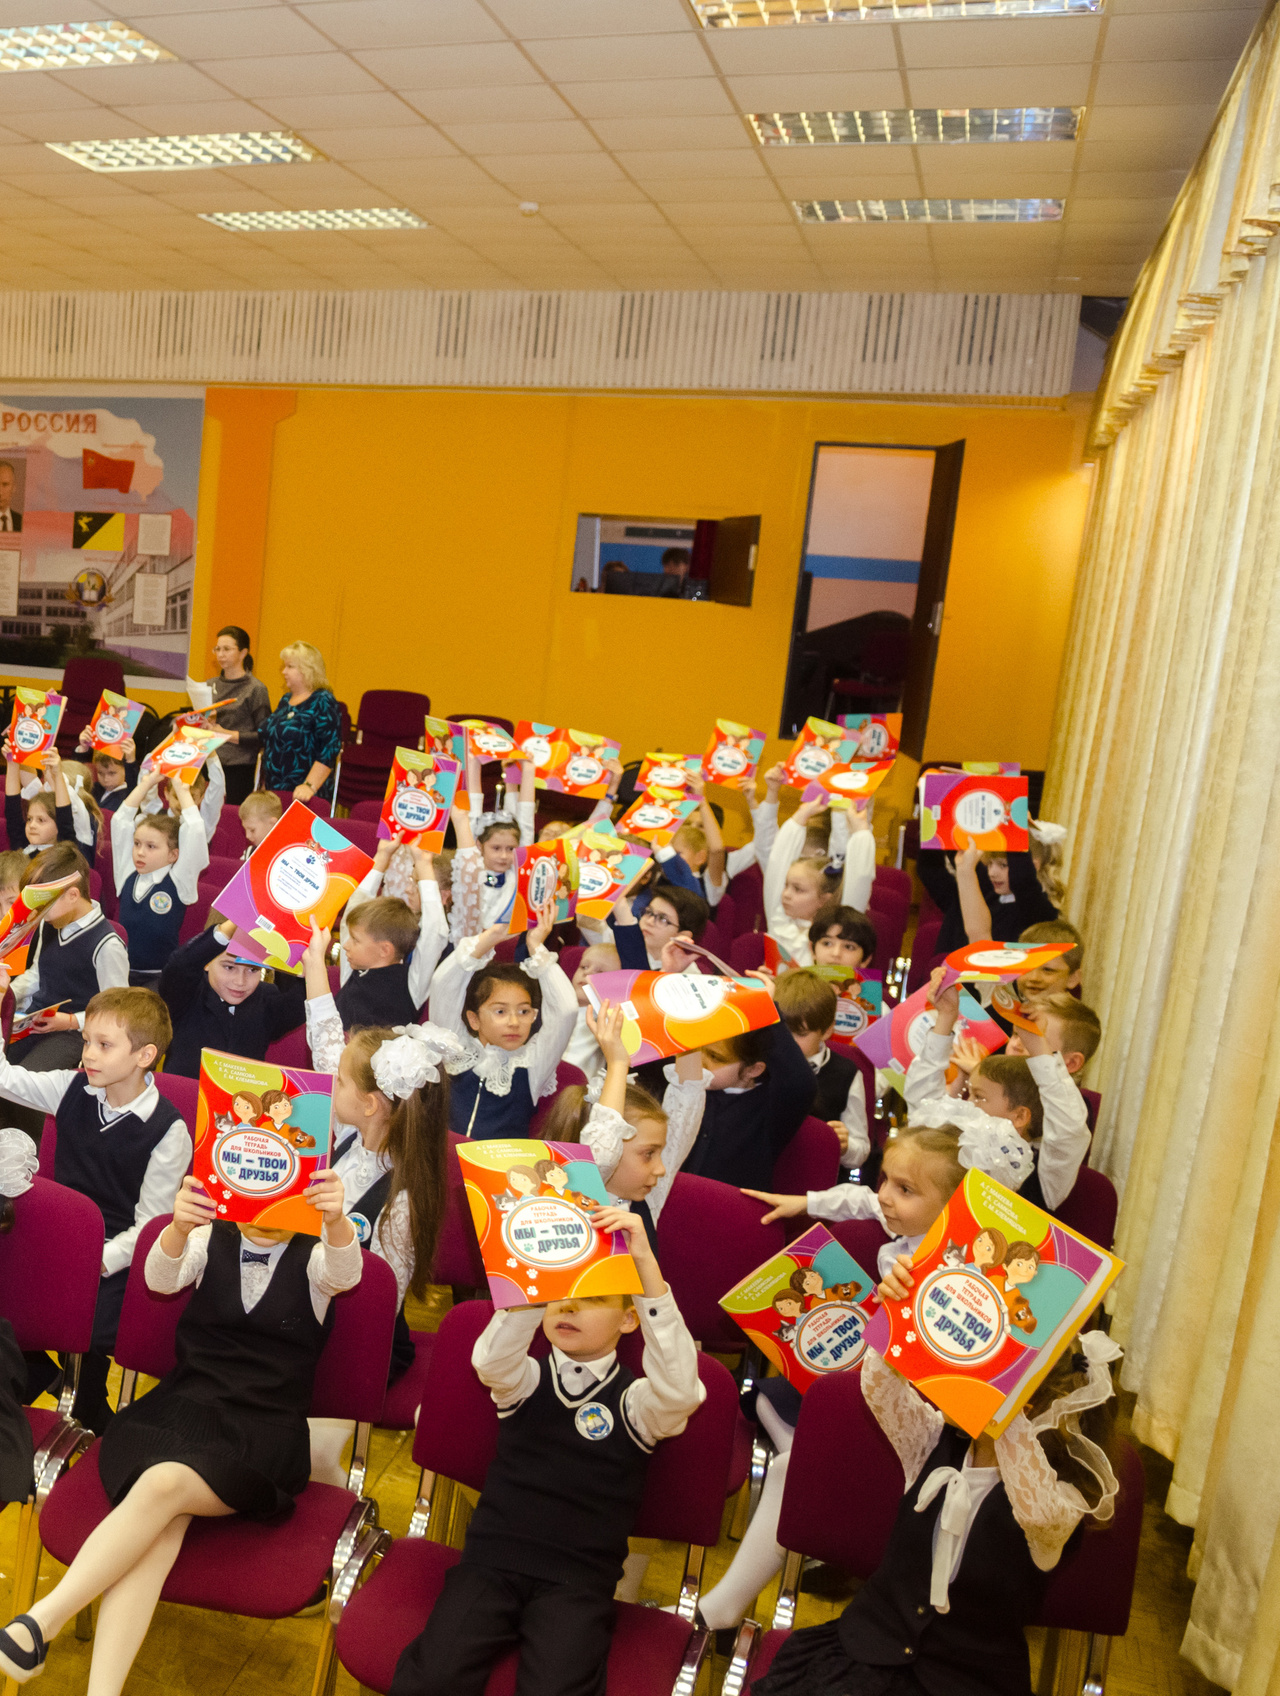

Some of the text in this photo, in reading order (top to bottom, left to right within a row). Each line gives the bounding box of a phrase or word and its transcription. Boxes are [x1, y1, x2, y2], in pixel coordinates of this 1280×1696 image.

[1, 412, 97, 433] РОССИЯ
[244, 1135, 269, 1143] РАБОЧАЯ
[245, 1141, 267, 1149] ТЕТРАДЬ
[222, 1151, 242, 1165] МЫ
[258, 1157, 287, 1170] ТВОИ
[243, 1148, 281, 1157] ШКОЛЬНИКОВ
[239, 1168, 279, 1182] ДРУЗЬЯ
[514, 1227, 536, 1240] МЫ
[552, 1223, 584, 1235] ТВОИ
[538, 1237, 580, 1253] ДРУЗЬЯ
[929, 1286, 952, 1310] МЫ
[962, 1311, 993, 1343] ТВОИ
[806, 1341, 826, 1360] МЫ
[832, 1315, 860, 1337] ТВОИ
[933, 1314, 976, 1352] ДРУЗЬЯ
[830, 1329, 861, 1361] ДРУЗЬЯ
